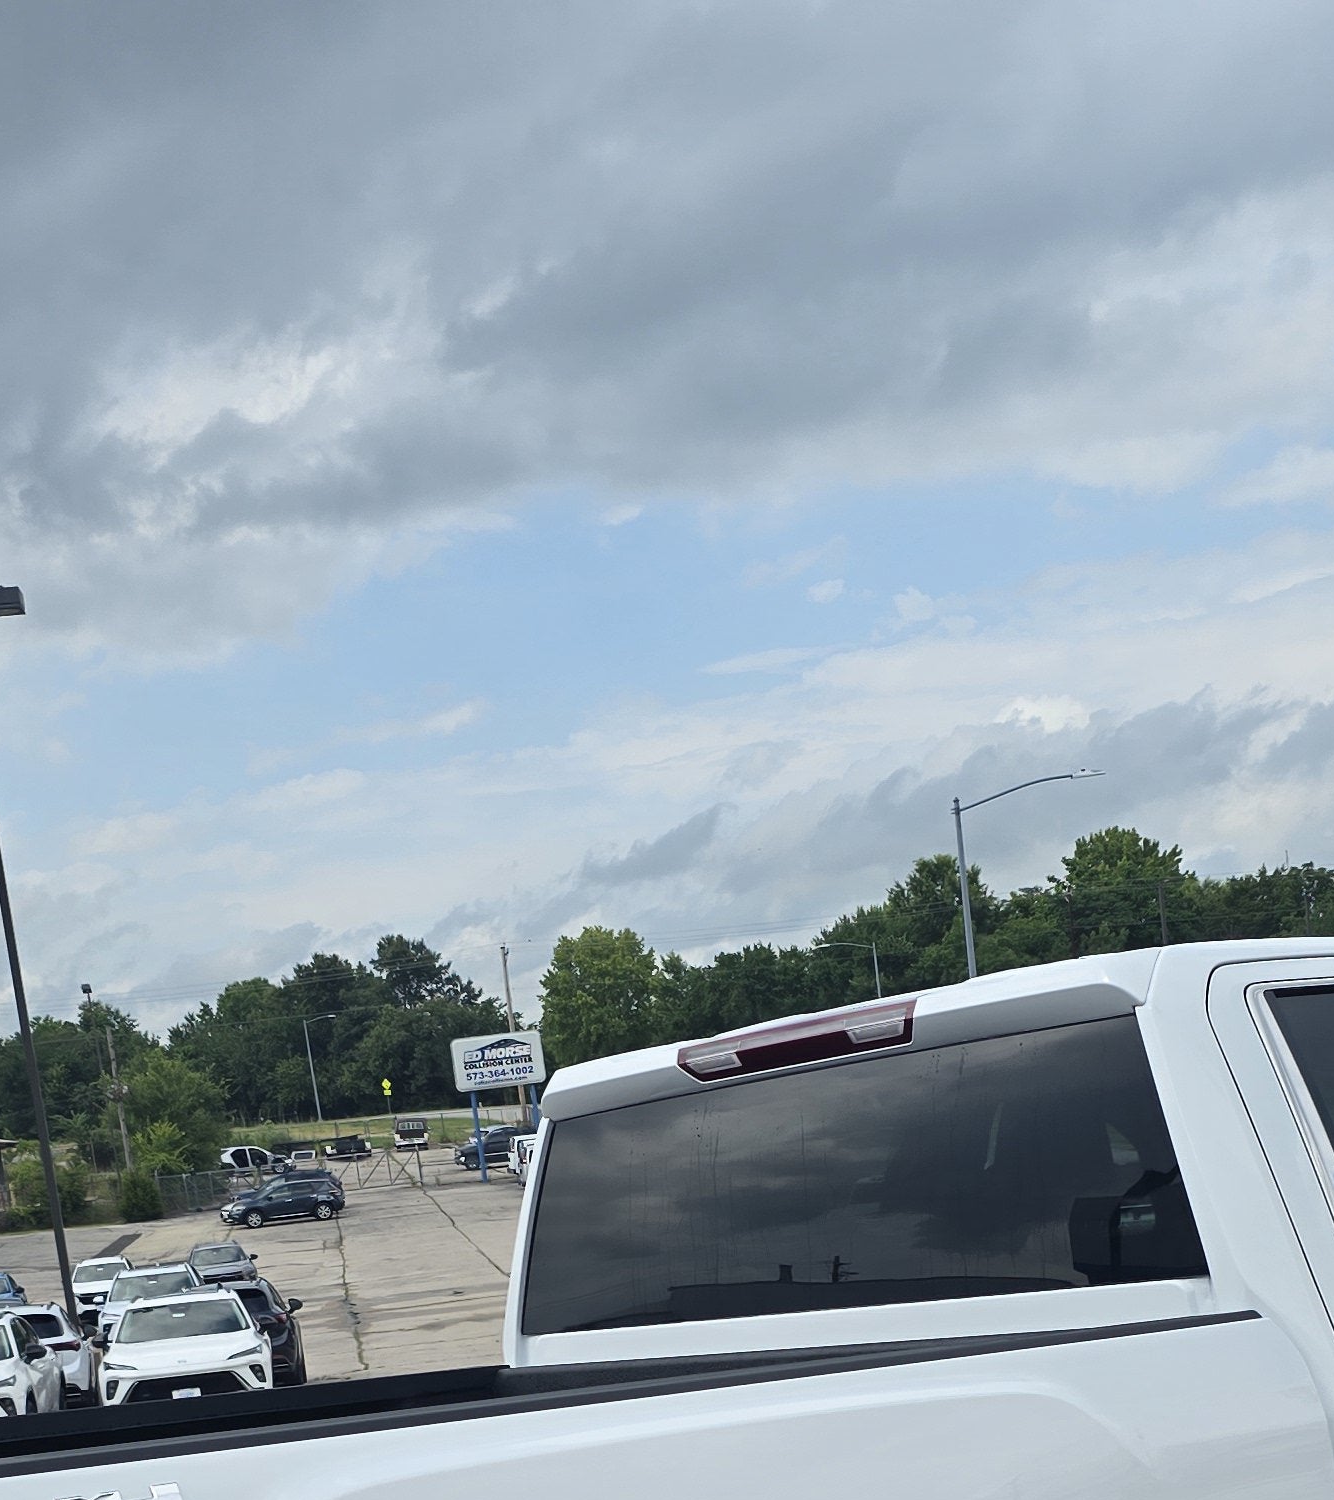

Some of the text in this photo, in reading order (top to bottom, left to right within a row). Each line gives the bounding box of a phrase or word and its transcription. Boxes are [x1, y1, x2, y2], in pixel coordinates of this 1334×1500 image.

[465, 1044, 531, 1063] ED MORSE
[464, 1056, 533, 1070] COLLISION CENTER
[466, 1066, 534, 1081] 573-364-1002
